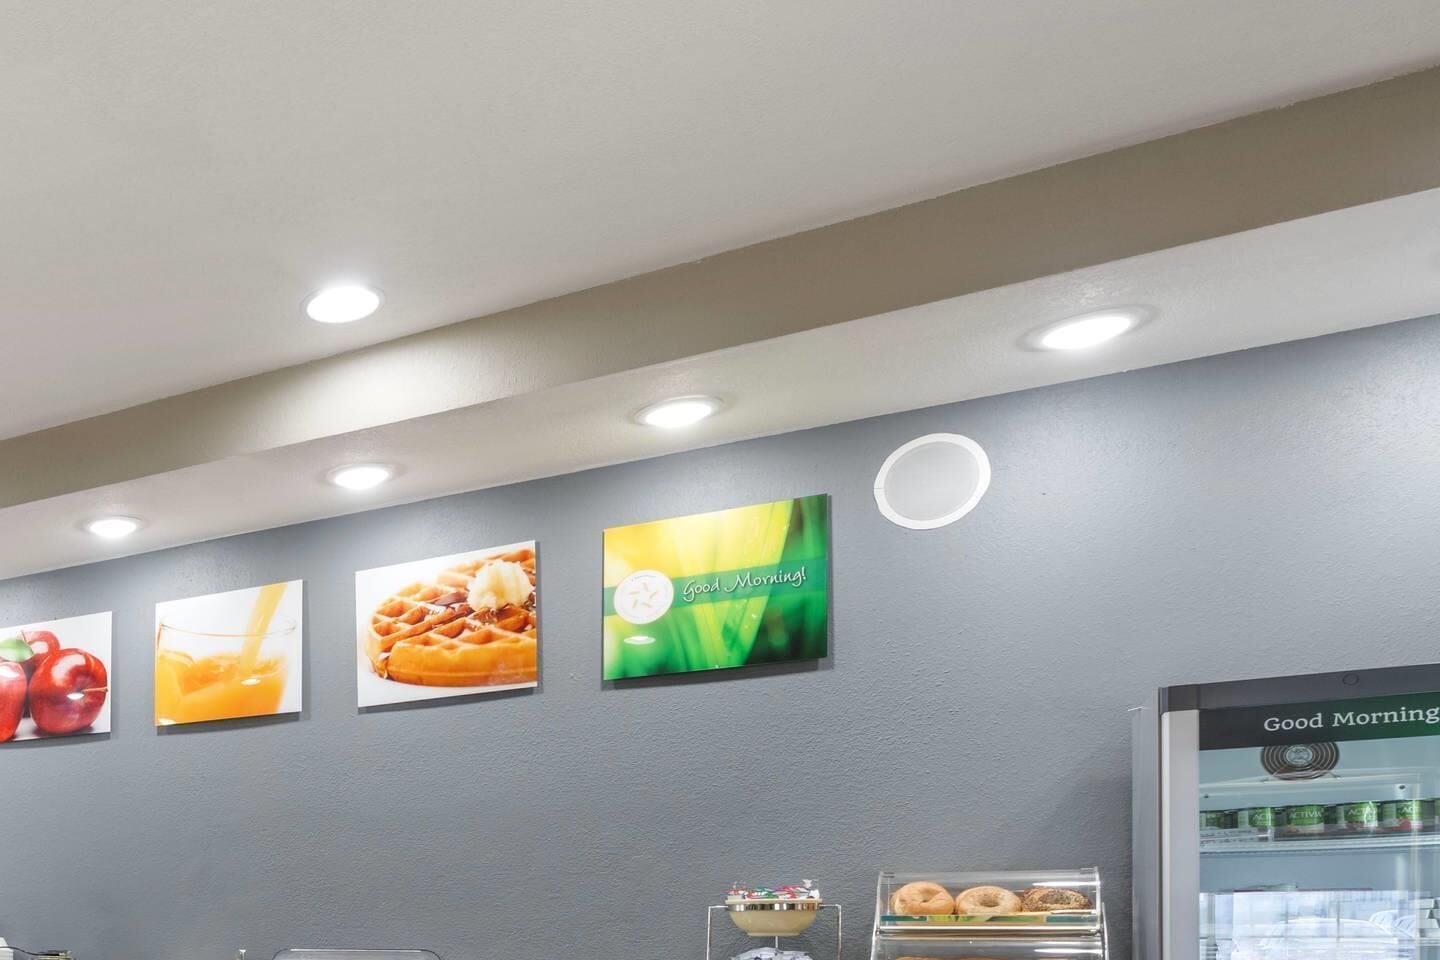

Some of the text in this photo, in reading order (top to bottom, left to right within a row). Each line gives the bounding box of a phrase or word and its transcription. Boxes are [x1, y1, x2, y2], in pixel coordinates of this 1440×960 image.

[682, 566, 807, 602] Good Morning!
[1263, 706, 1440, 732] Good Morning
